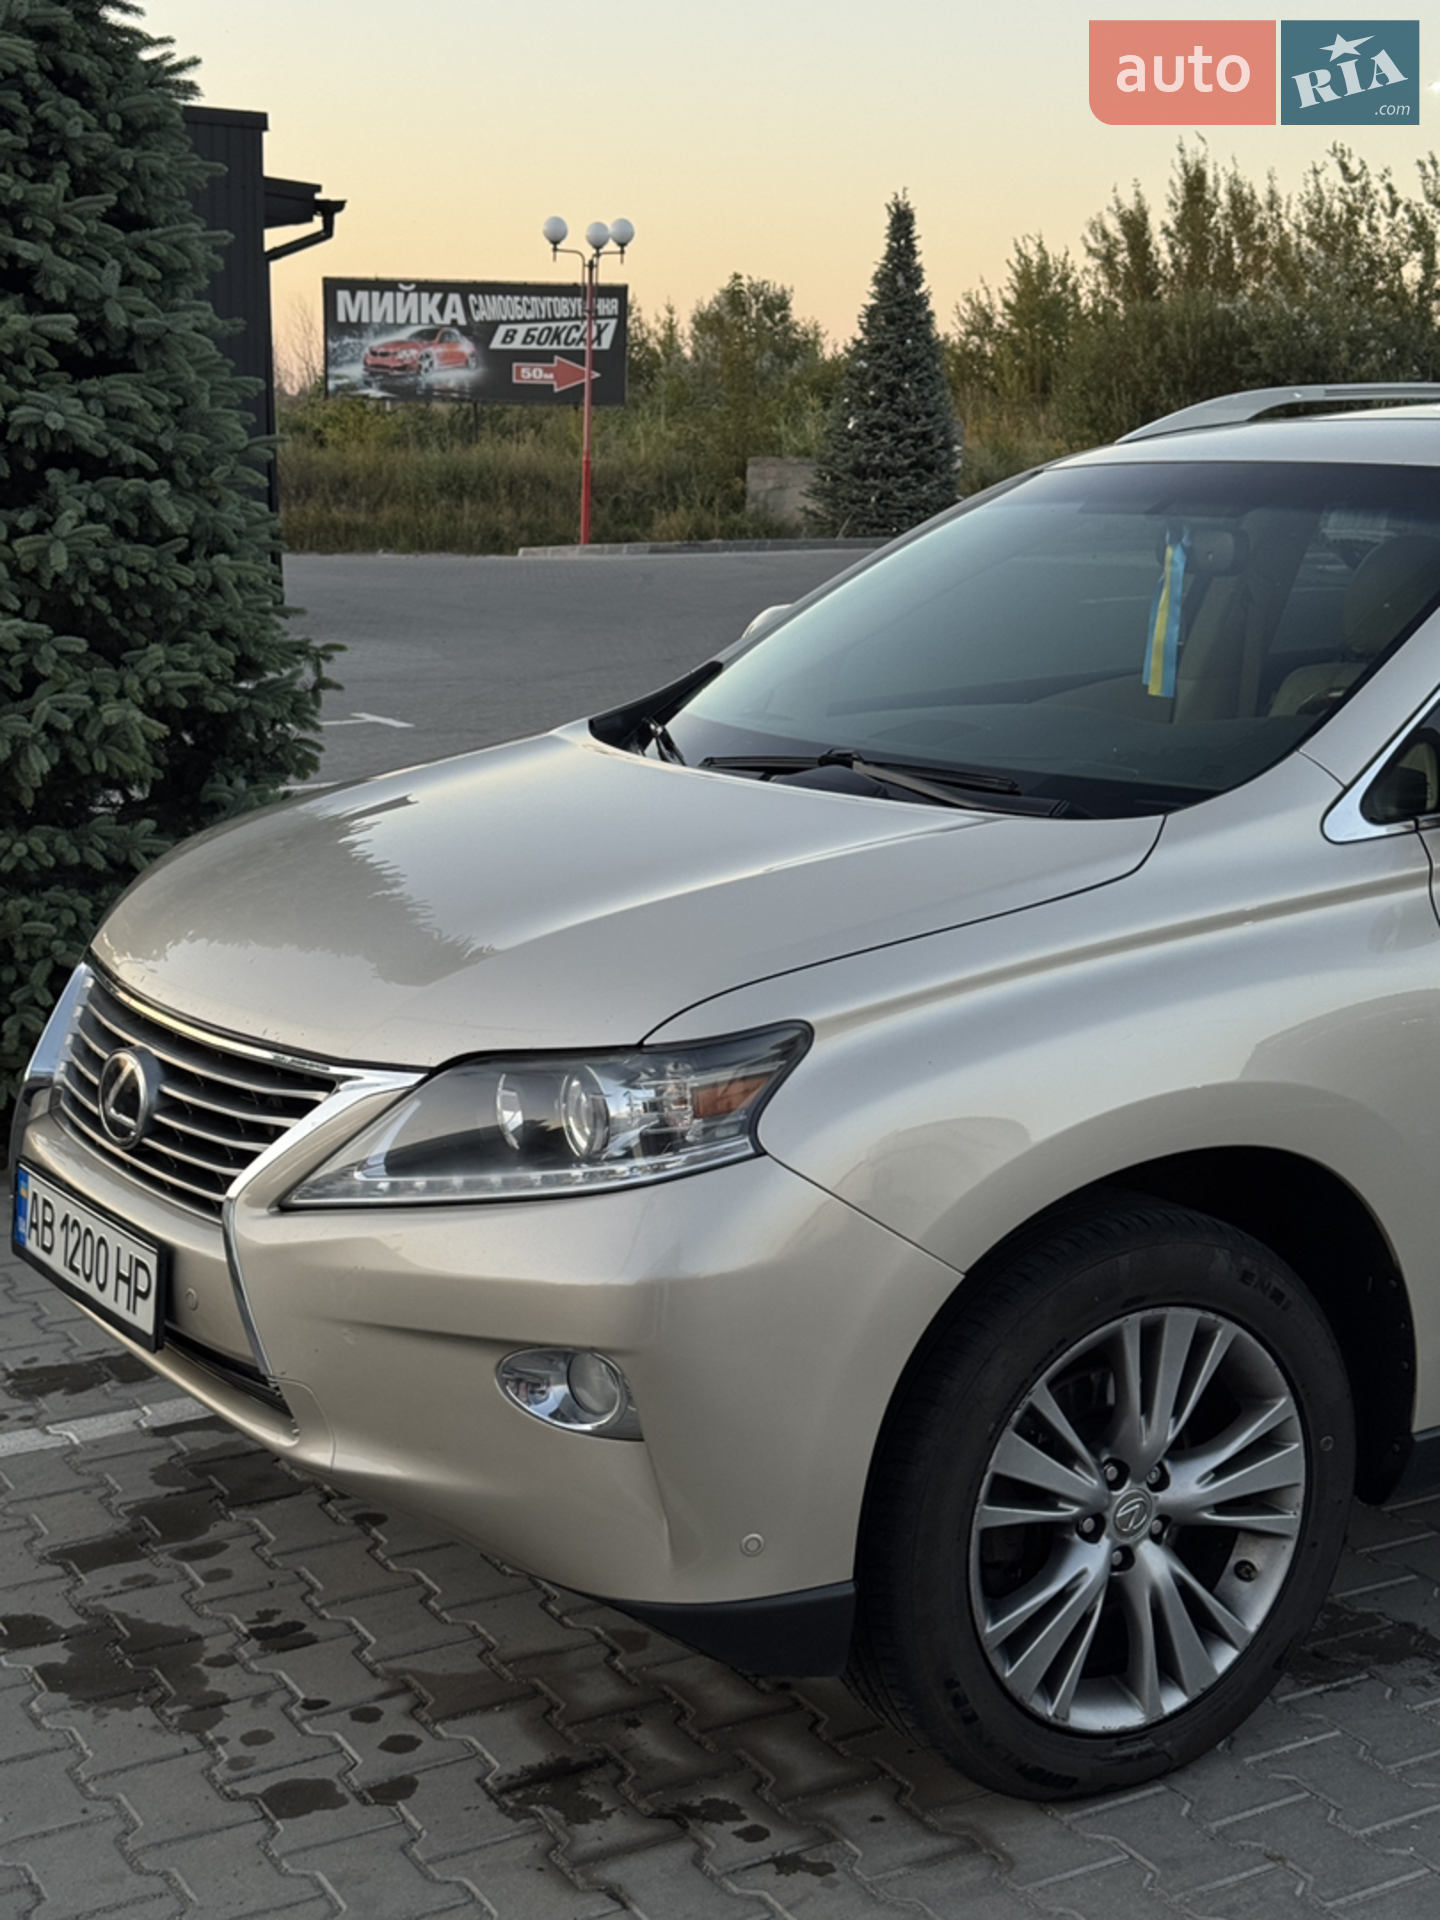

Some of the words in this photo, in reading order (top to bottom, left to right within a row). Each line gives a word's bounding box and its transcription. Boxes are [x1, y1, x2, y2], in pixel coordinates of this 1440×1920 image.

[336, 282, 467, 326] МИЙКА
[468, 293, 619, 322] САМООБСЛУГОВУННЯ
[500, 328, 519, 345] В
[28, 1190, 55, 1256] AB
[60, 1211, 109, 1293] 1200
[113, 1245, 152, 1316] HP
